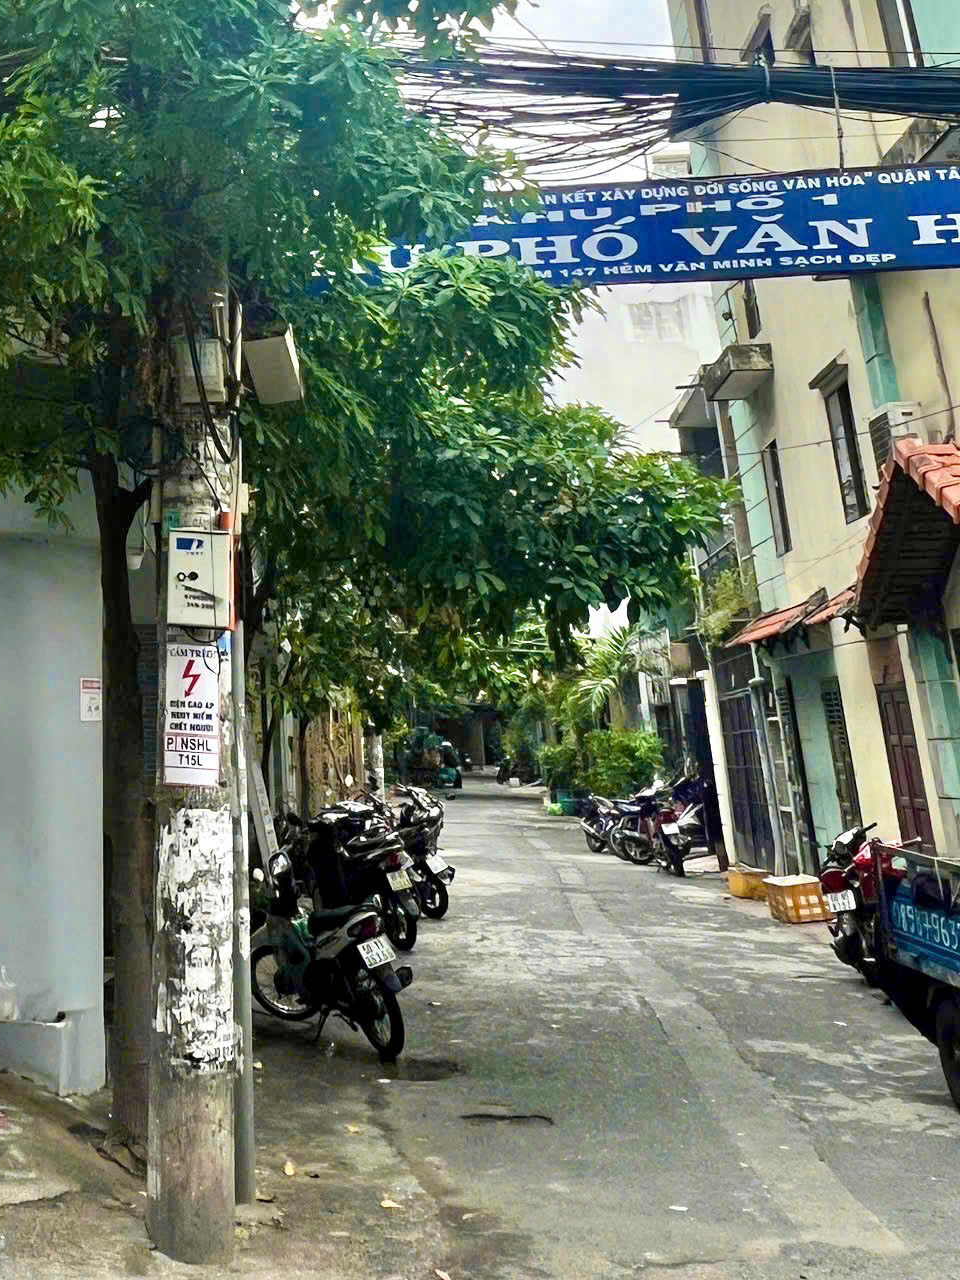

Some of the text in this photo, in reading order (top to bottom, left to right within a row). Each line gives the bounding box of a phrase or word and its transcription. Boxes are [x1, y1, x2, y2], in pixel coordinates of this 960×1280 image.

[562, 189, 596, 205] KẾT
[601, 187, 635, 202] XÂY
[641, 186, 689, 201] DỰNG
[693, 181, 724, 196] ĐỜI
[728, 178, 778, 194] SỐNG
[785, 176, 820, 190] VĂN
[878, 169, 931, 185] QUẬN
[640, 192, 784, 216] PHỐ
[812, 193, 838, 206] 1
[456, 216, 638, 266] PHỐ
[672, 213, 873, 256] VĂN
[560, 267, 596, 278] 147
[659, 261, 705, 272] VĂN
[713, 258, 772, 269] MINH
[779, 255, 840, 268] SẠCH
[849, 253, 897, 266] ĐẸP
[181, 737, 212, 752] NSHL
[178, 753, 203, 766] T15L
